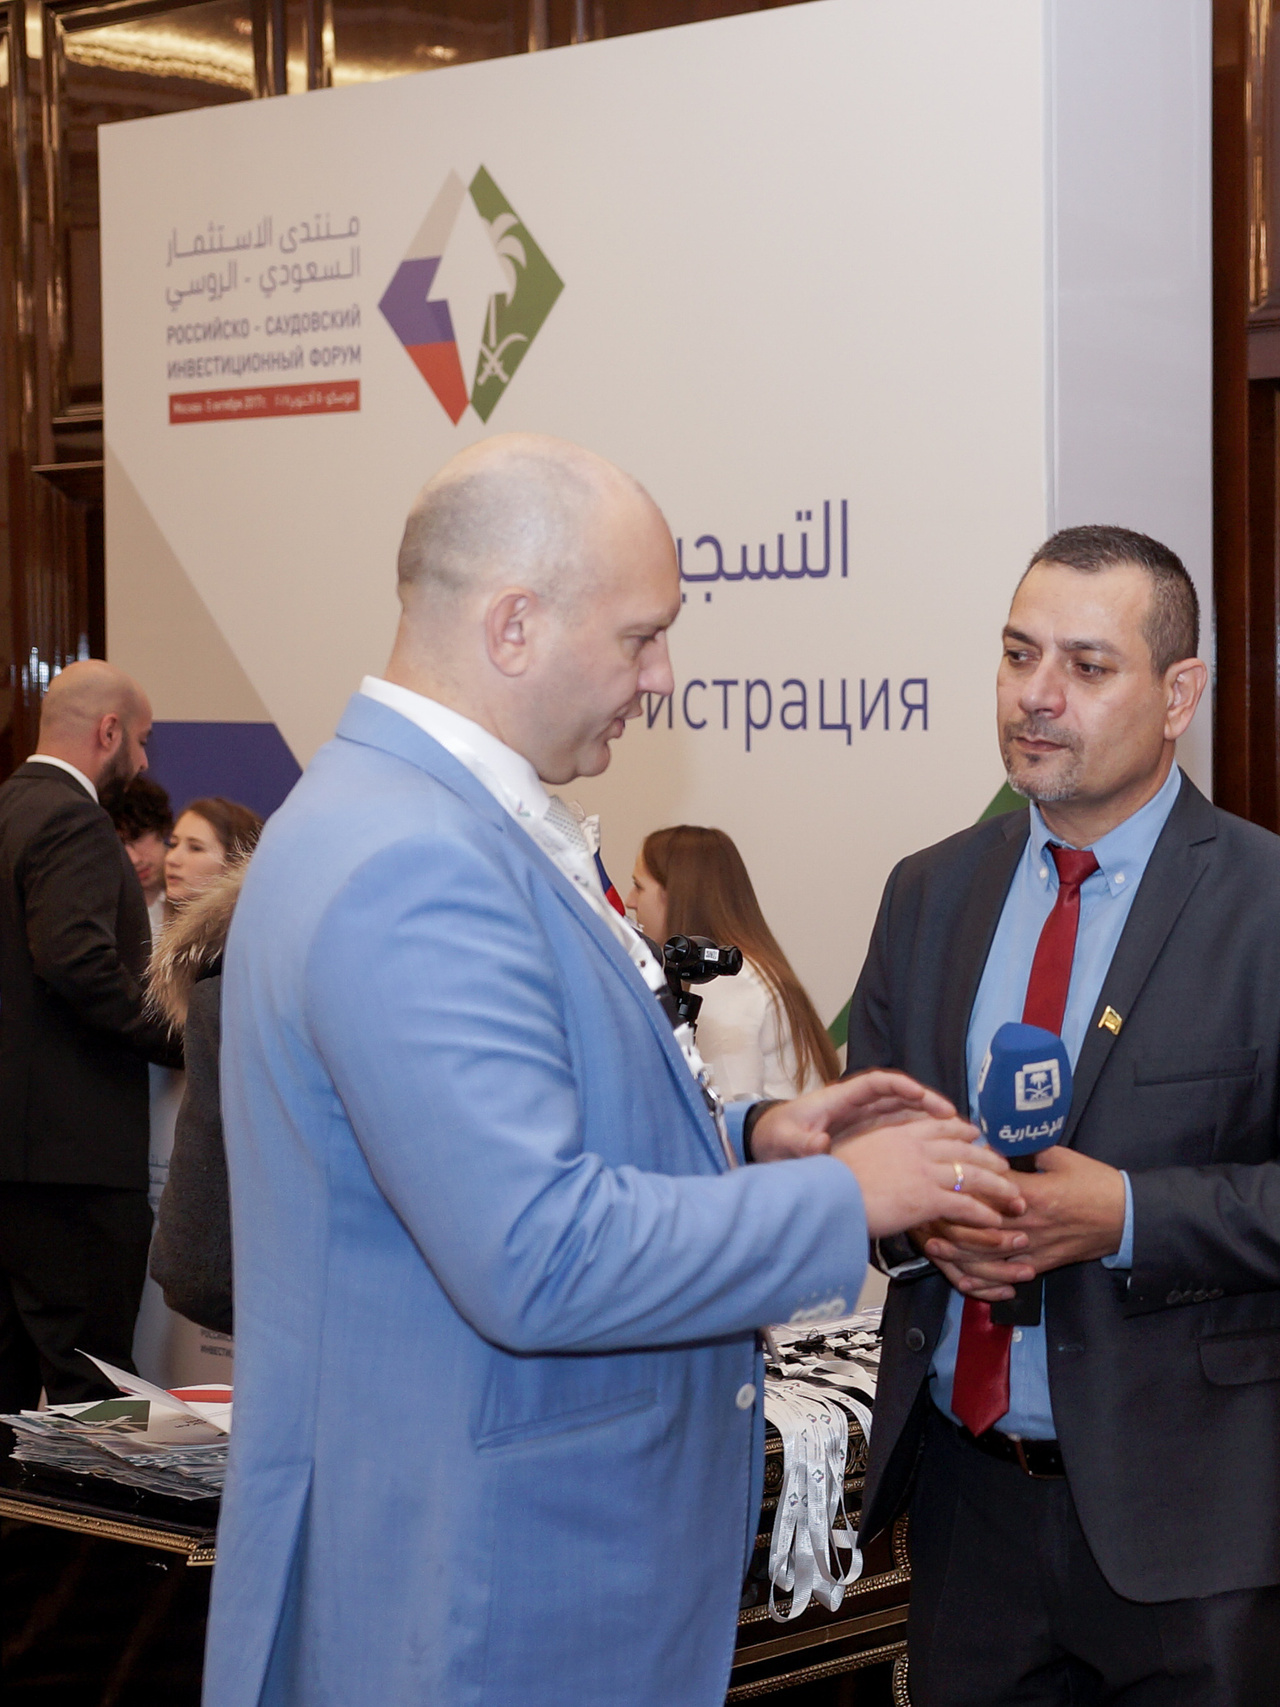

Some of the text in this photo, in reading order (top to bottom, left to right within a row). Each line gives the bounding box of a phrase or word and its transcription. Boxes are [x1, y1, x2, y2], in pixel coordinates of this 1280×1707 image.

[166, 212, 360, 267] منتدى الاستثمار
[166, 260, 237, 312] الروسي
[259, 246, 360, 298] السعودي
[167, 317, 249, 346] РОССИЙСКО
[265, 303, 361, 337] САУДОВСКИЙ
[167, 345, 361, 380] ИНВЕСТИЦИОННЫЙ ФОРУМ
[676, 499, 848, 604] التسجي
[646, 677, 929, 753] истрация
